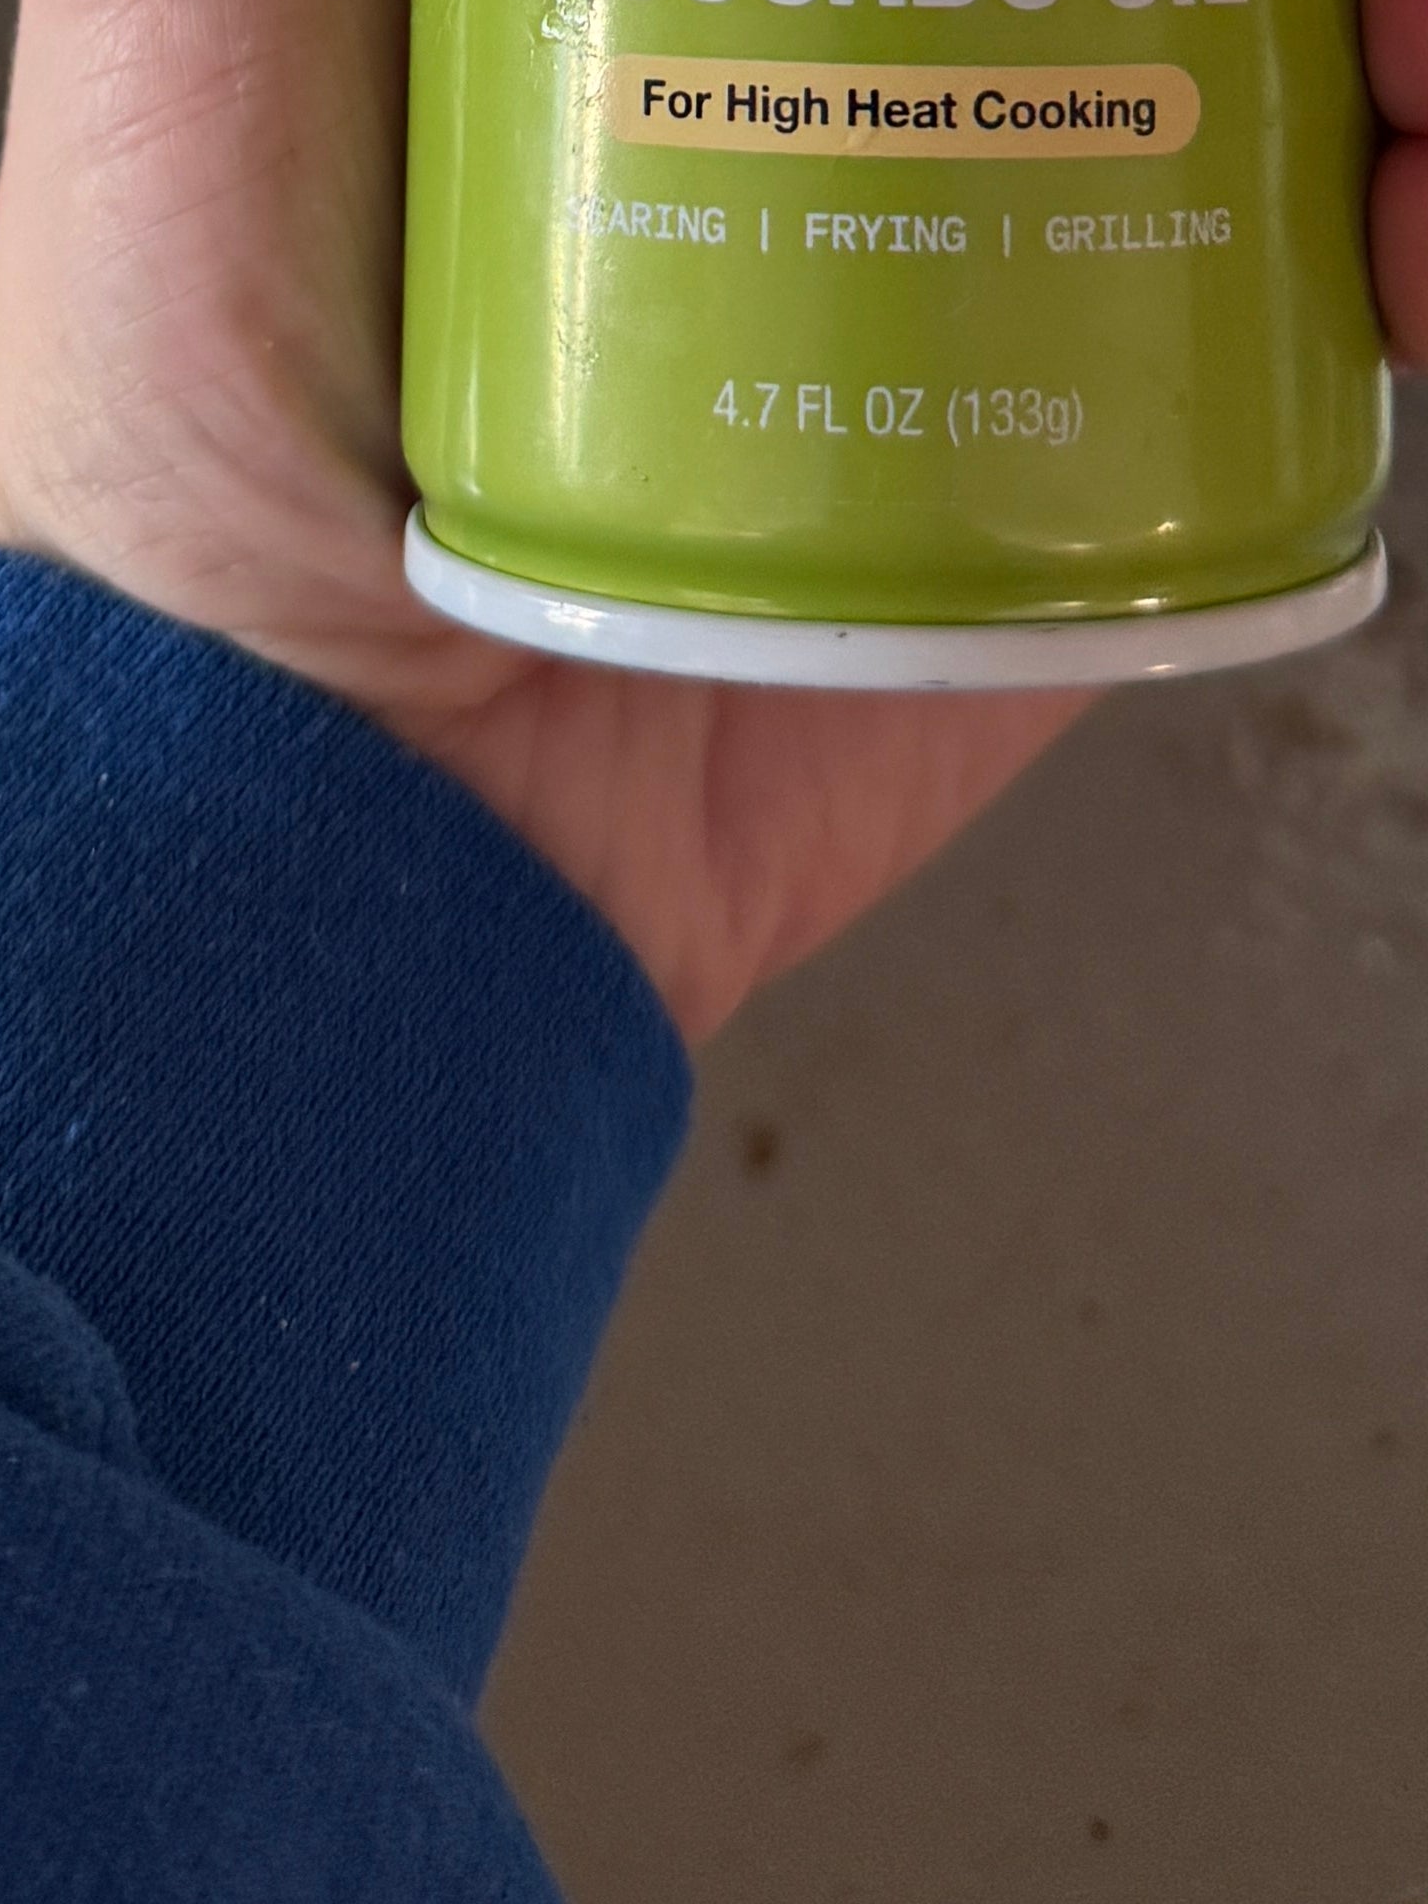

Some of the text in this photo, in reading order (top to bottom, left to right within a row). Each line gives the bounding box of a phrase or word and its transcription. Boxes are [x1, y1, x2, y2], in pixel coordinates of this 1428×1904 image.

[642, 78, 1158, 136] For High Heat Cooking
[804, 212, 968, 254] FRYING
[1044, 207, 1232, 254] GRILLING
[712, 378, 1084, 449] 4.7 FL OZ (133g)
